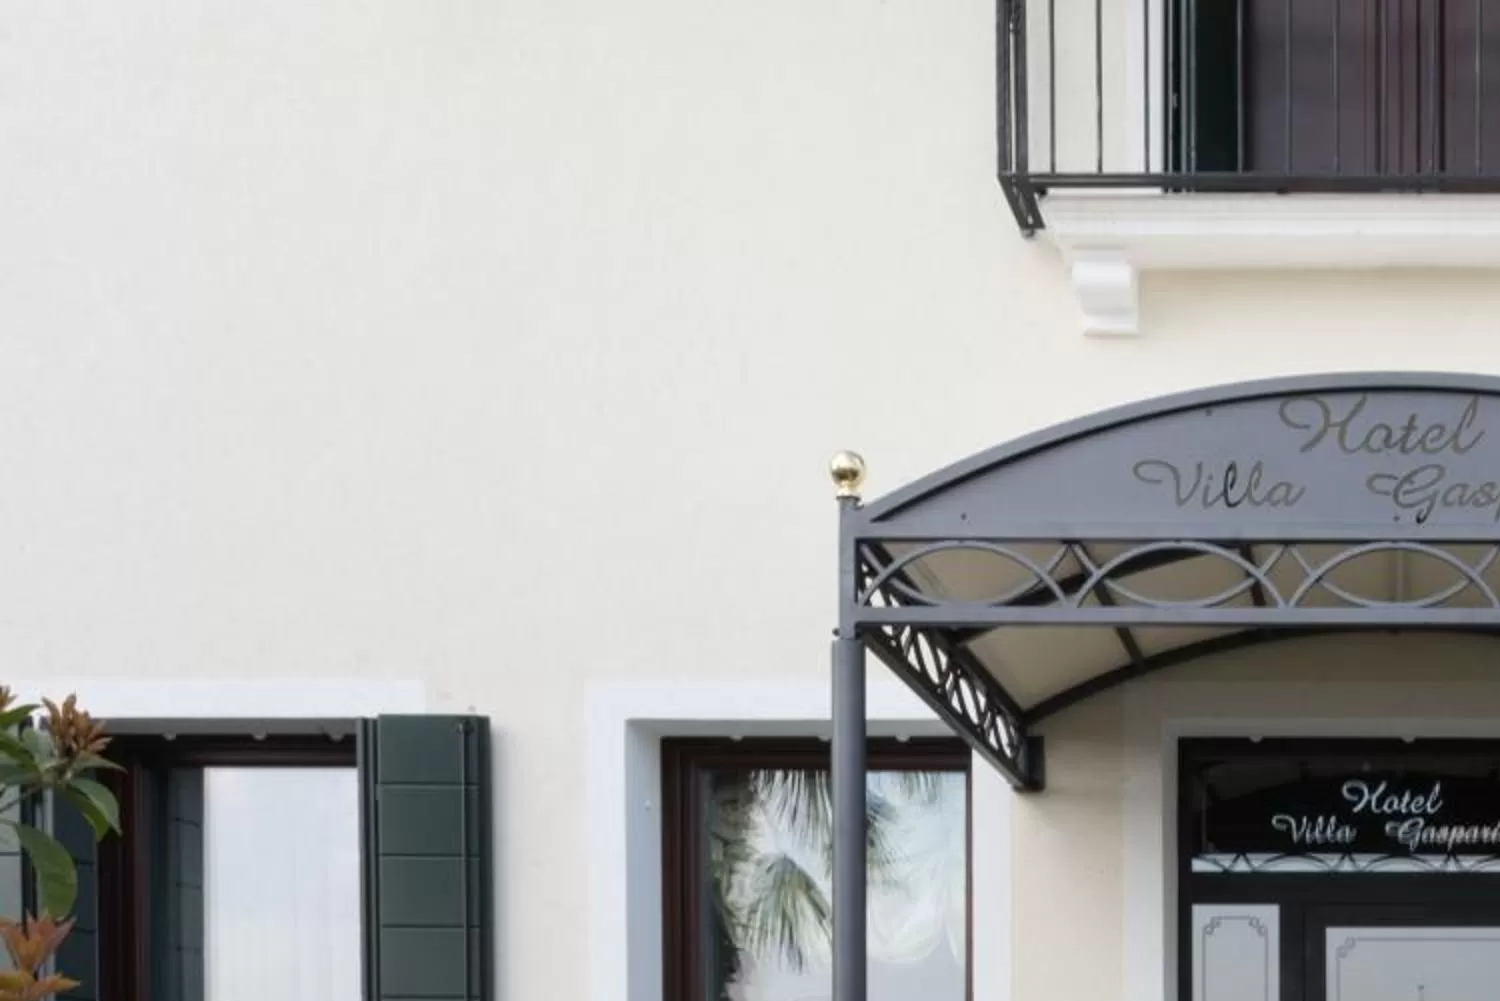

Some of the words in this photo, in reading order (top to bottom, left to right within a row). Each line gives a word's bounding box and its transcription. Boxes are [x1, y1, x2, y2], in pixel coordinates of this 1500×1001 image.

[1279, 394, 1486, 455] Hotel
[1133, 460, 1304, 508] Villa
[1342, 780, 1443, 813] Hotel
[1272, 815, 1357, 844] Villa
